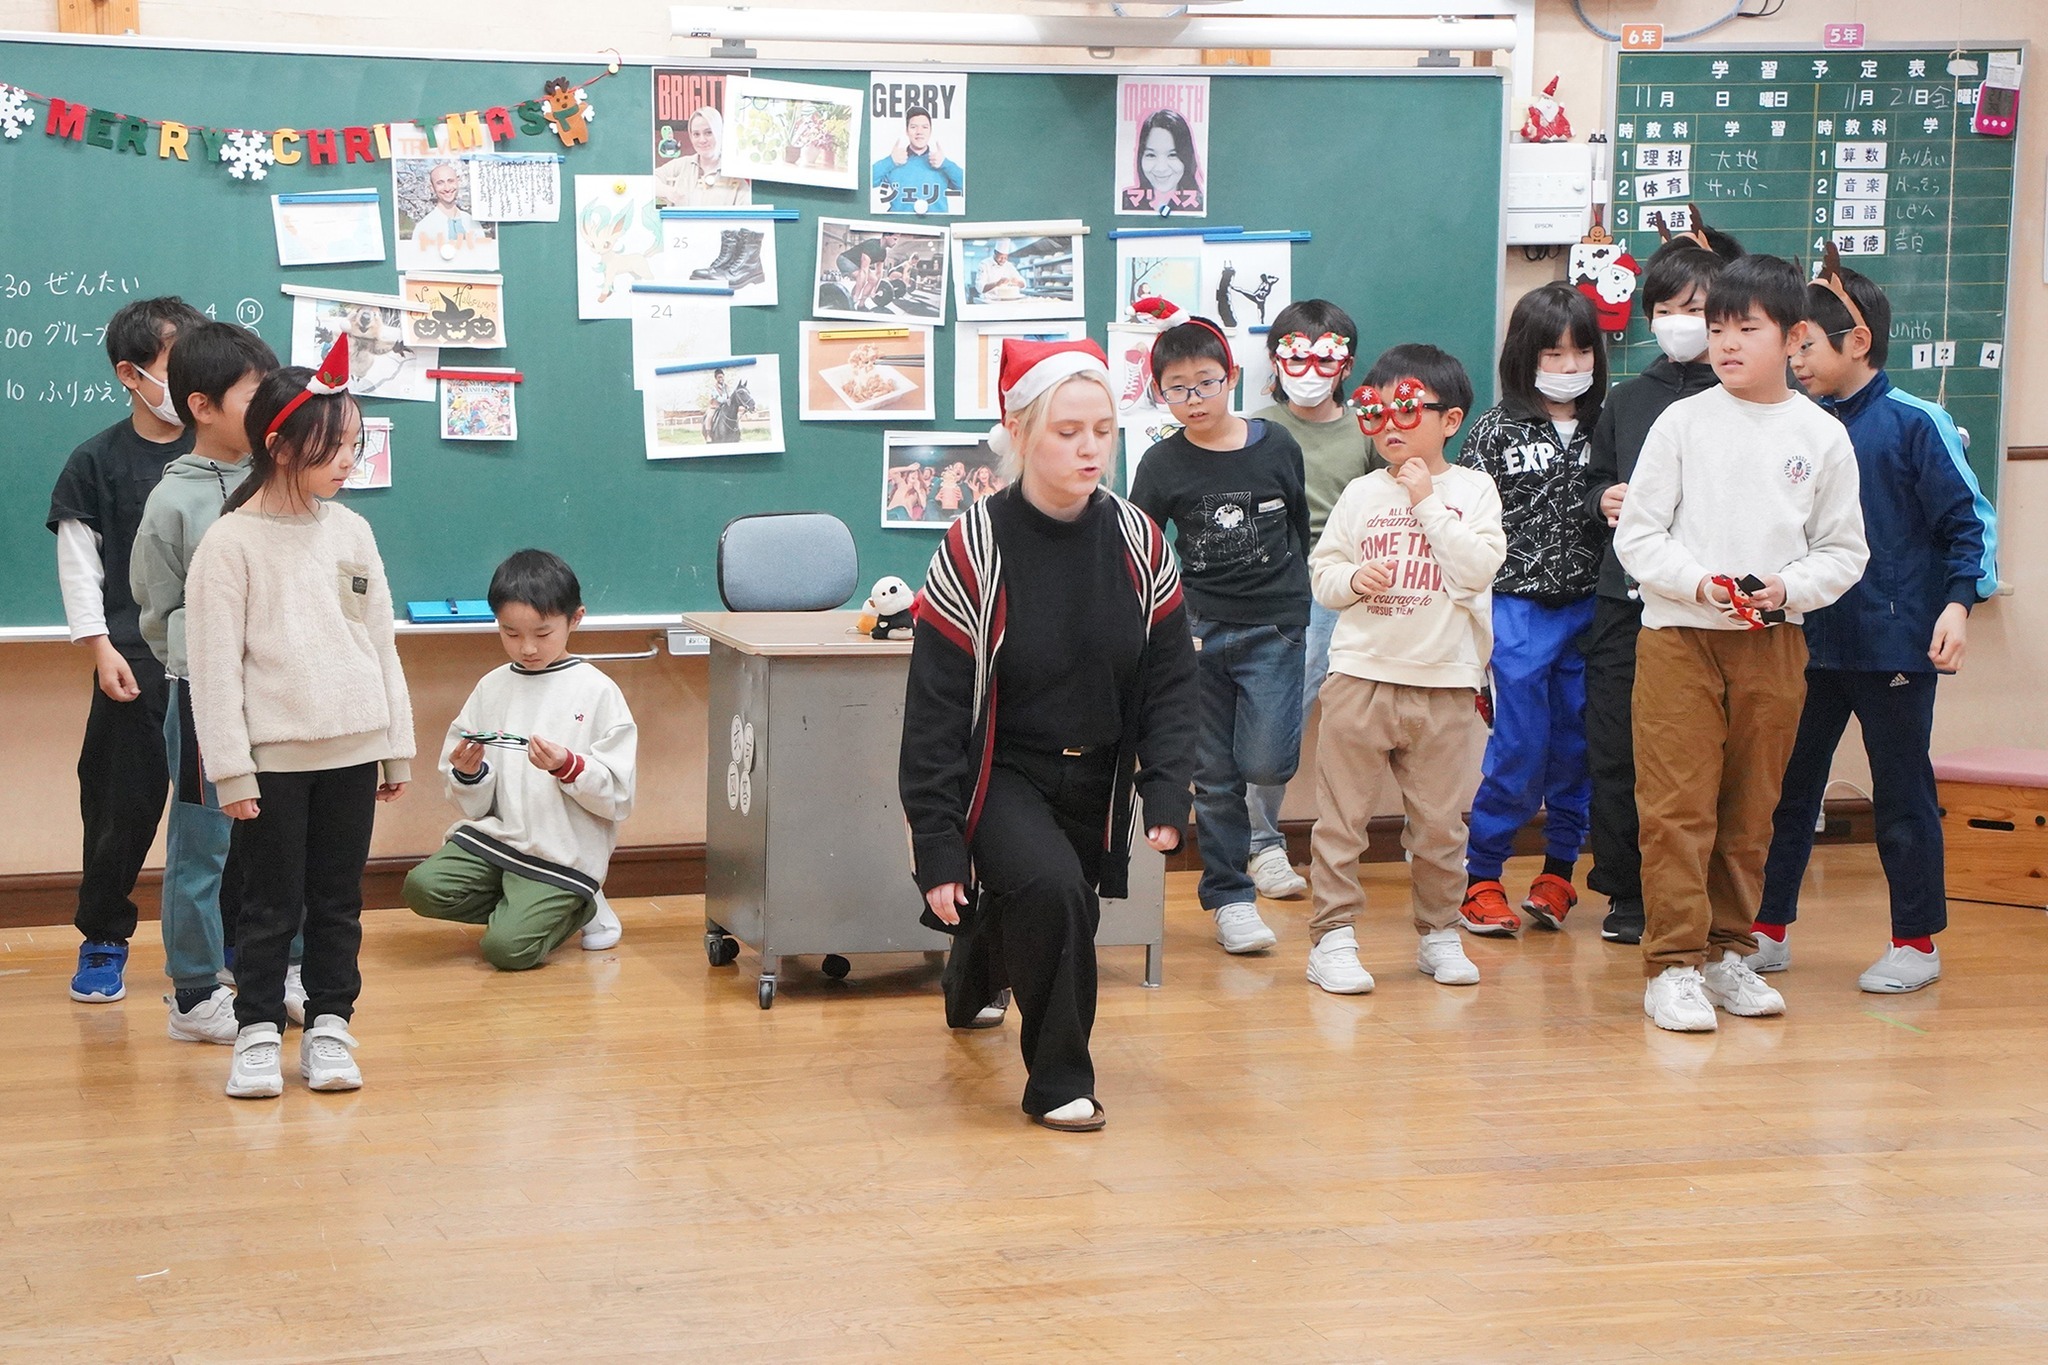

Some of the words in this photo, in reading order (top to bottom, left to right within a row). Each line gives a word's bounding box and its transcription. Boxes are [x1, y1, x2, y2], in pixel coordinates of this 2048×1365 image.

[1628, 30, 1657, 45] 6年
[1830, 28, 1857, 43] 5年
[1711, 58, 1926, 80] 学習予定表
[872, 83, 956, 119] GERRY
[1759, 91, 1788, 107] 曜日
[45, 97, 226, 162] MERRY
[272, 100, 546, 166] CHRITMAS
[1618, 122, 1634, 139] 時
[1646, 121, 1688, 138] 教科
[1724, 120, 1786, 138] 学習
[1817, 119, 1833, 136] 時
[1845, 118, 1887, 136] 教科
[1621, 150, 1629, 166] 1
[1643, 149, 1682, 167] 理科
[1820, 149, 1827, 165] 1
[1843, 147, 1879, 163] 算数
[880, 183, 962, 204] ジェリー
[1618, 180, 1630, 196] 2
[1643, 178, 1682, 198] 体育
[1816, 179, 1828, 194] 2
[1844, 178, 1880, 193] 音楽
[1127, 188, 1200, 208] マリベス
[1616, 208, 1629, 225] 3
[1815, 208, 1827, 223] 3
[1842, 205, 1877, 219] 国語
[673, 237, 689, 249] 25
[1813, 236, 1825, 252] 4
[1839, 235, 1879, 252] 道徳
[45, 270, 140, 296] ぜんたい
[651, 304, 673, 319] 24
[1919, 351, 1925, 362] 1
[1941, 348, 1949, 360] 2
[1986, 350, 1995, 361] 4
[1388, 508, 1402, 516] ALL
[1366, 514, 1418, 529] dreams
[1402, 560, 1447, 592] HAV
[1373, 594, 1420, 607] courage
[1420, 594, 1433, 606] to
[1366, 605, 1394, 616] PURSUE
